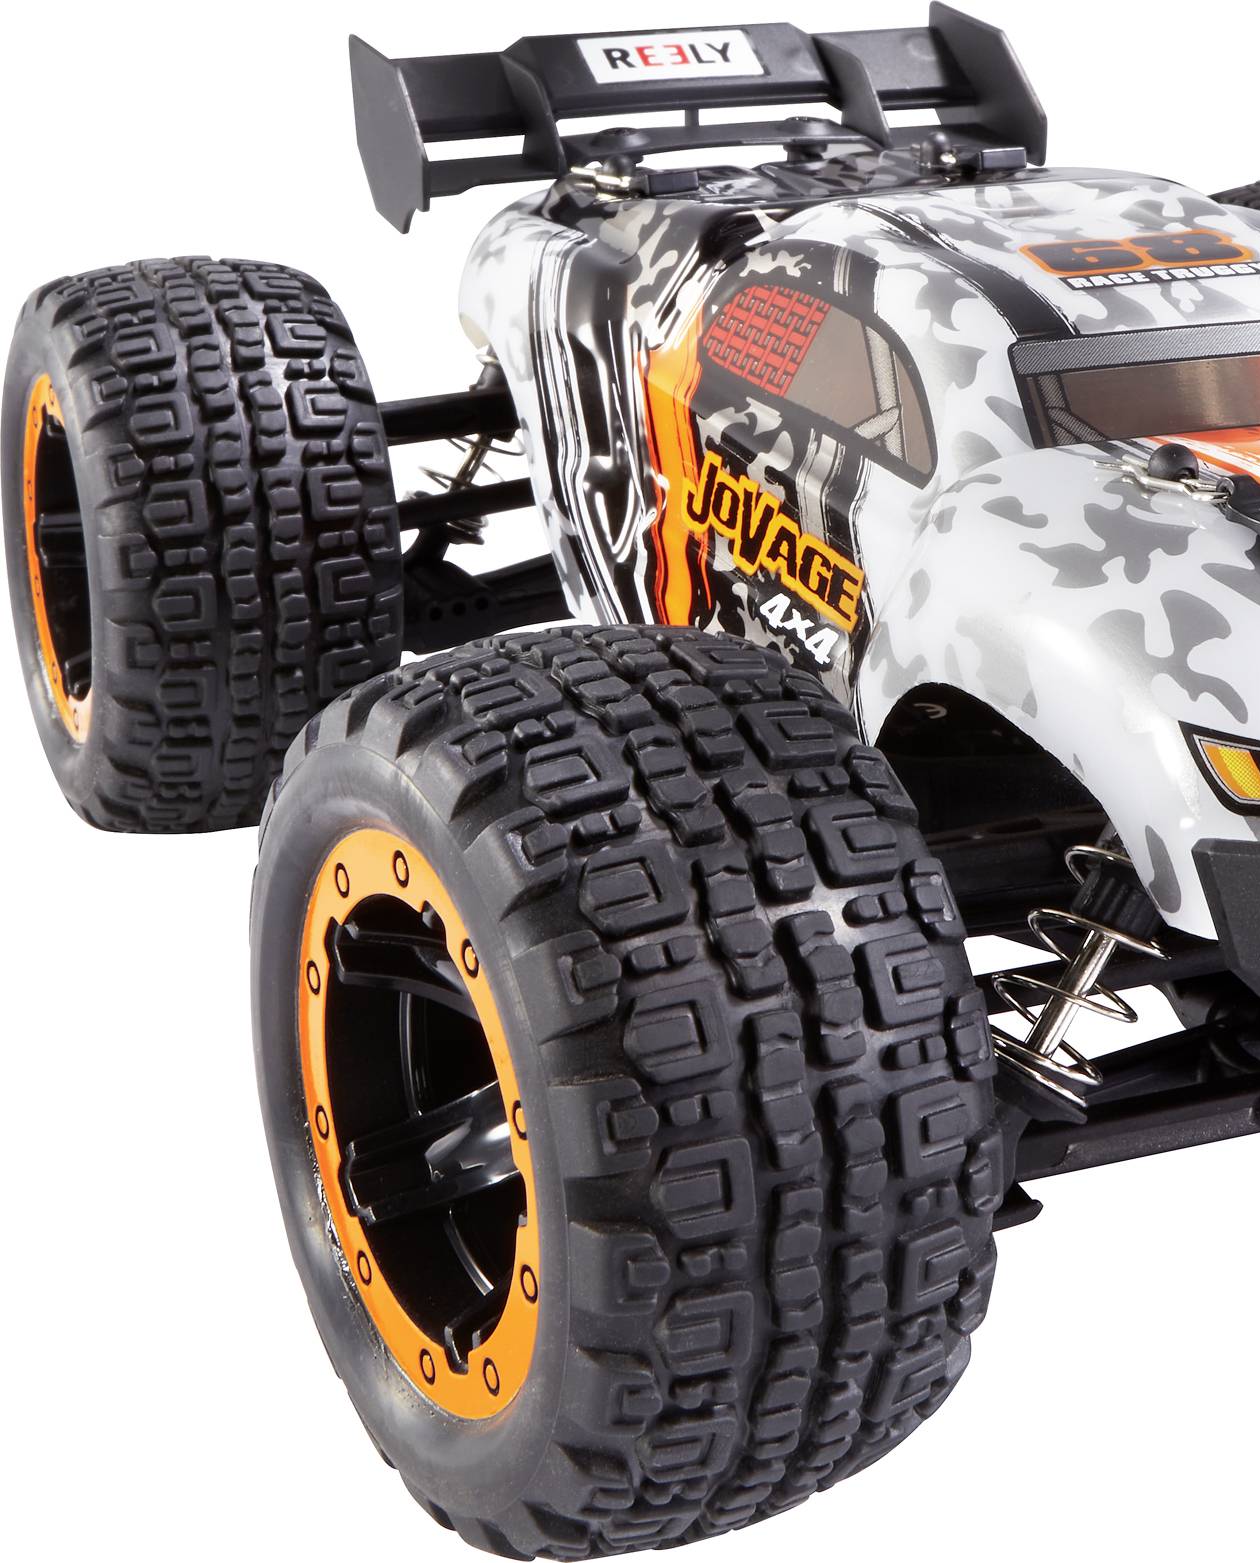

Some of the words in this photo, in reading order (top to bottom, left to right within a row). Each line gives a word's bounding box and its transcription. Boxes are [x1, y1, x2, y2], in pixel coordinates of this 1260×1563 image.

[602, 42, 730, 70] REELY
[1019, 229, 1254, 276] 68
[1066, 270, 1149, 290] RACE
